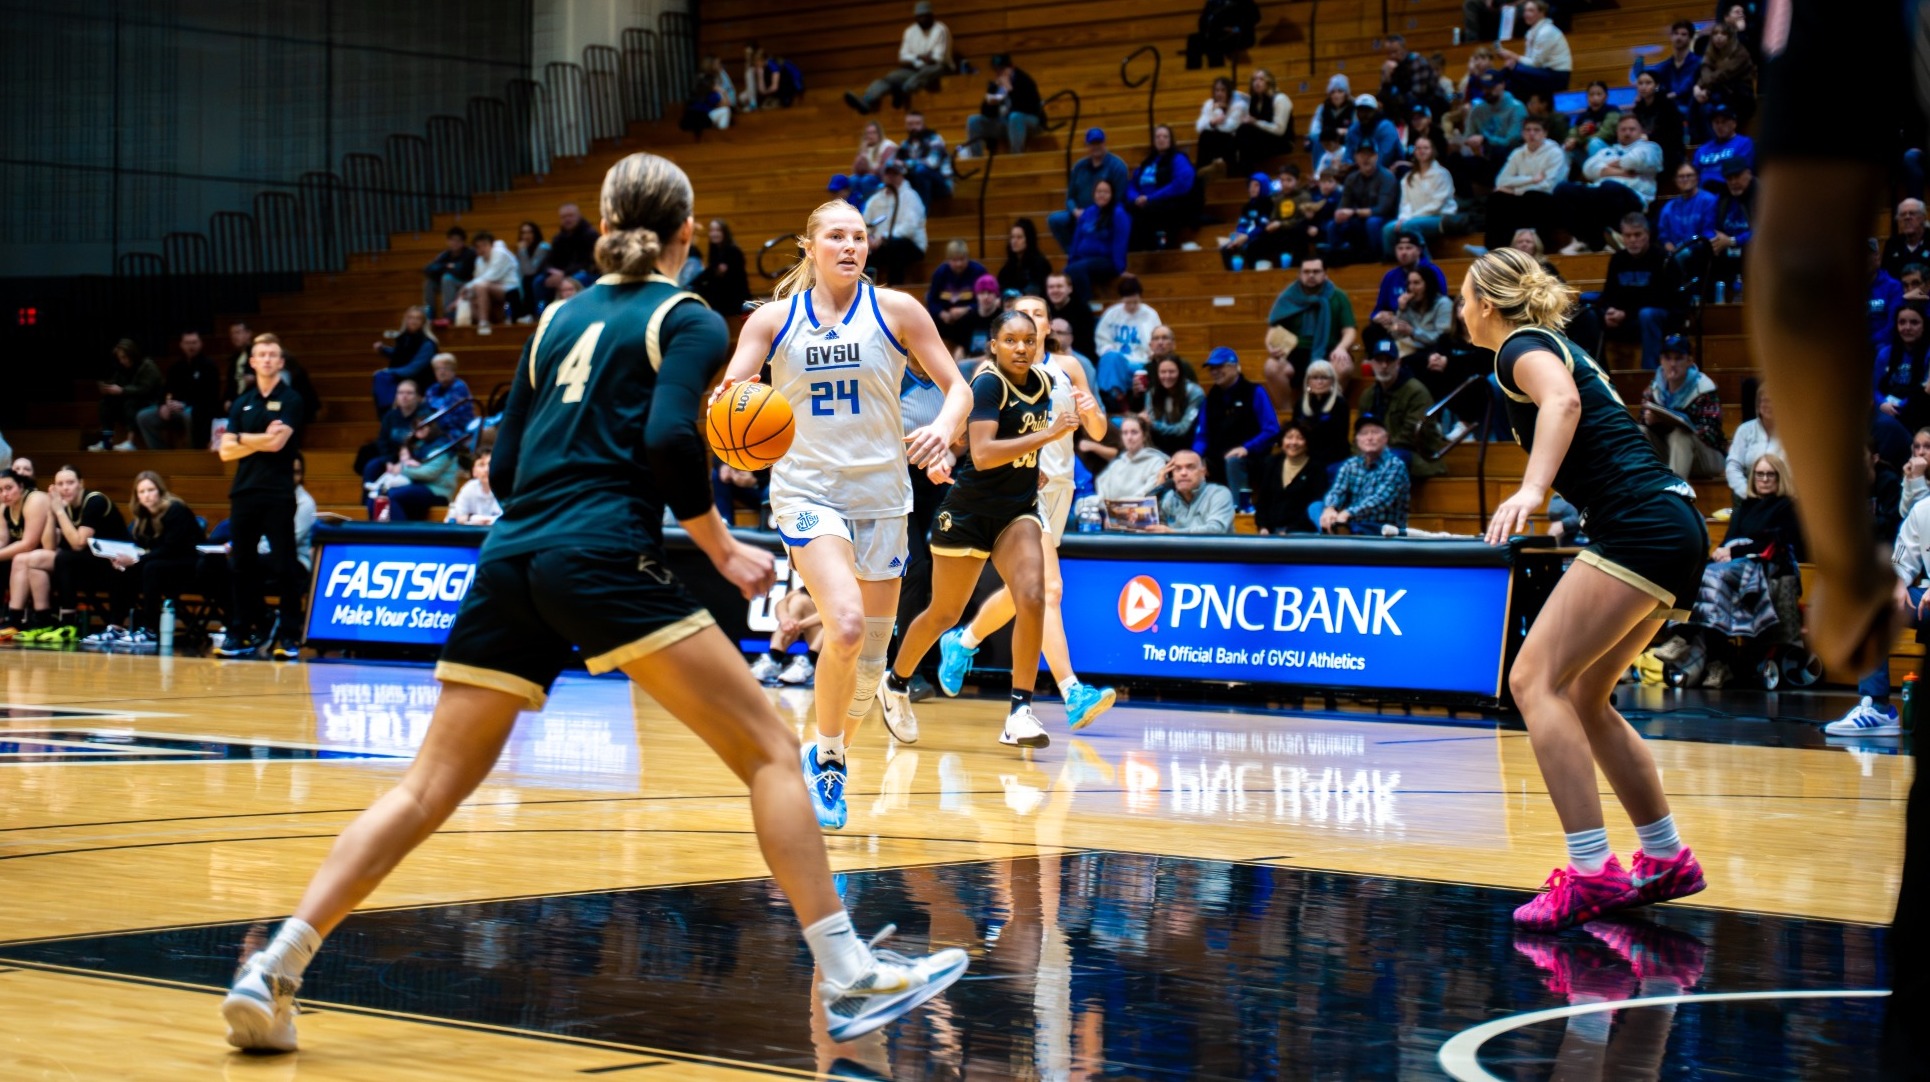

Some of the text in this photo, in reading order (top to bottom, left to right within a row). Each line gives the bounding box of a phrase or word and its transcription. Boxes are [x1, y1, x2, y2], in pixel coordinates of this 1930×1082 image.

[556, 321, 606, 404] 4
[806, 343, 859, 366] GVSU
[810, 379, 861, 417] 24
[1018, 410, 1048, 434] Prid
[331, 604, 373, 626] Make
[374, 606, 409, 628] Your
[1142, 644, 1366, 671] The Official Bank of GVSU Athletics
